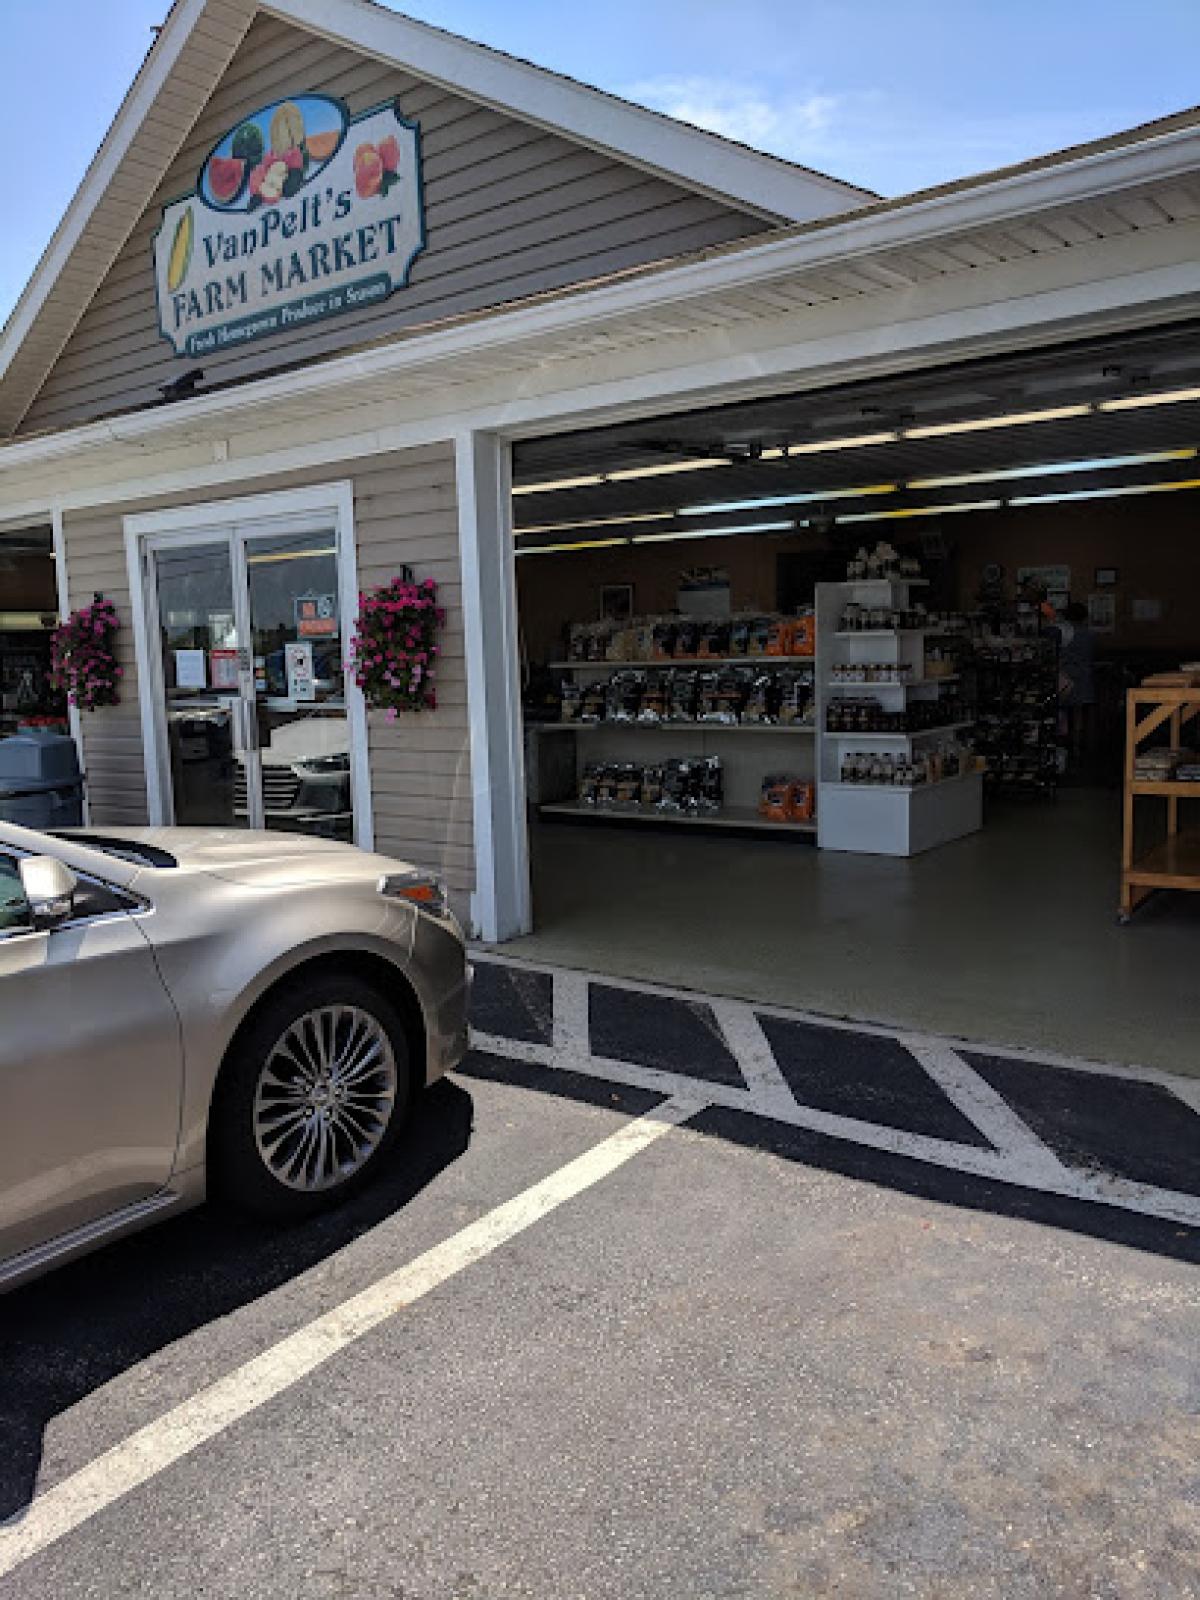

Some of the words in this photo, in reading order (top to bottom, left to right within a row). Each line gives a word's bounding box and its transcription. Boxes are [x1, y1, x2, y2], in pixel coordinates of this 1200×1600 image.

[173, 271, 248, 328] FARM
[260, 214, 401, 297] MARKET
[202, 187, 352, 268] VanPelt's
